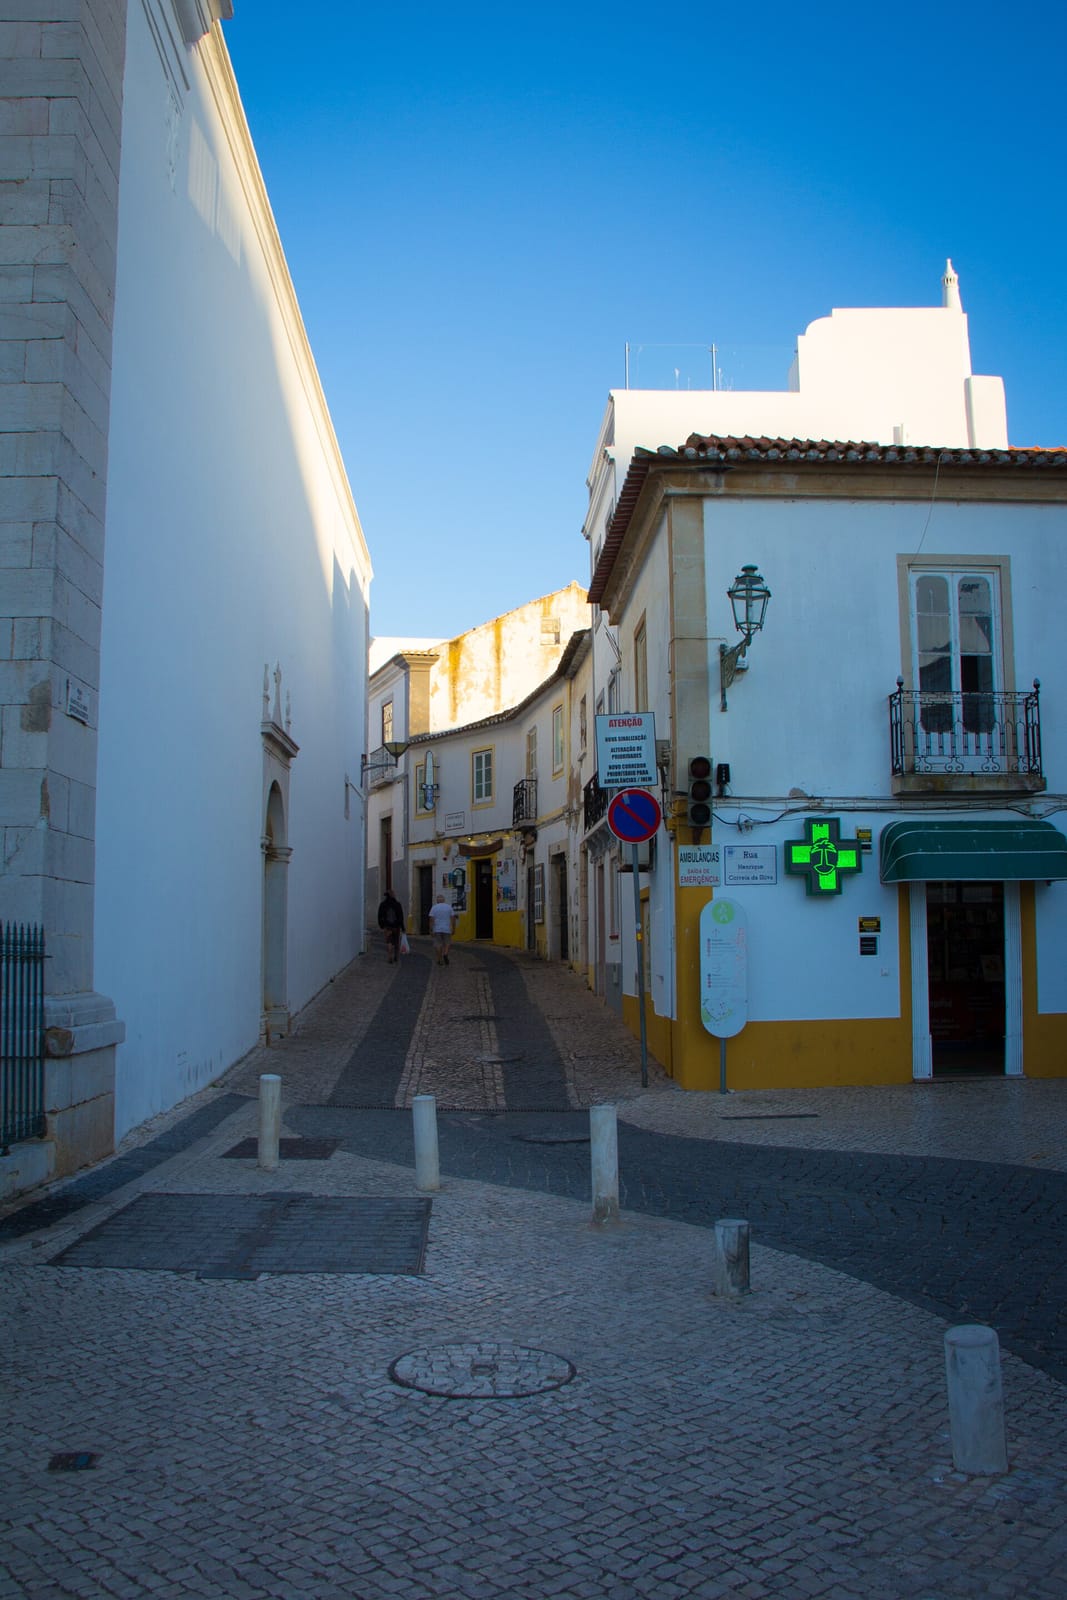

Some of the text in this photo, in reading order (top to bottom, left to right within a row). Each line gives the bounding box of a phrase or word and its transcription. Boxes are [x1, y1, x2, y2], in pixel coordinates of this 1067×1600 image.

[609, 716, 642, 728] ATENÇÃO
[743, 851, 758, 859] Rua
[681, 874, 719, 883] EMERGÊNCIA
